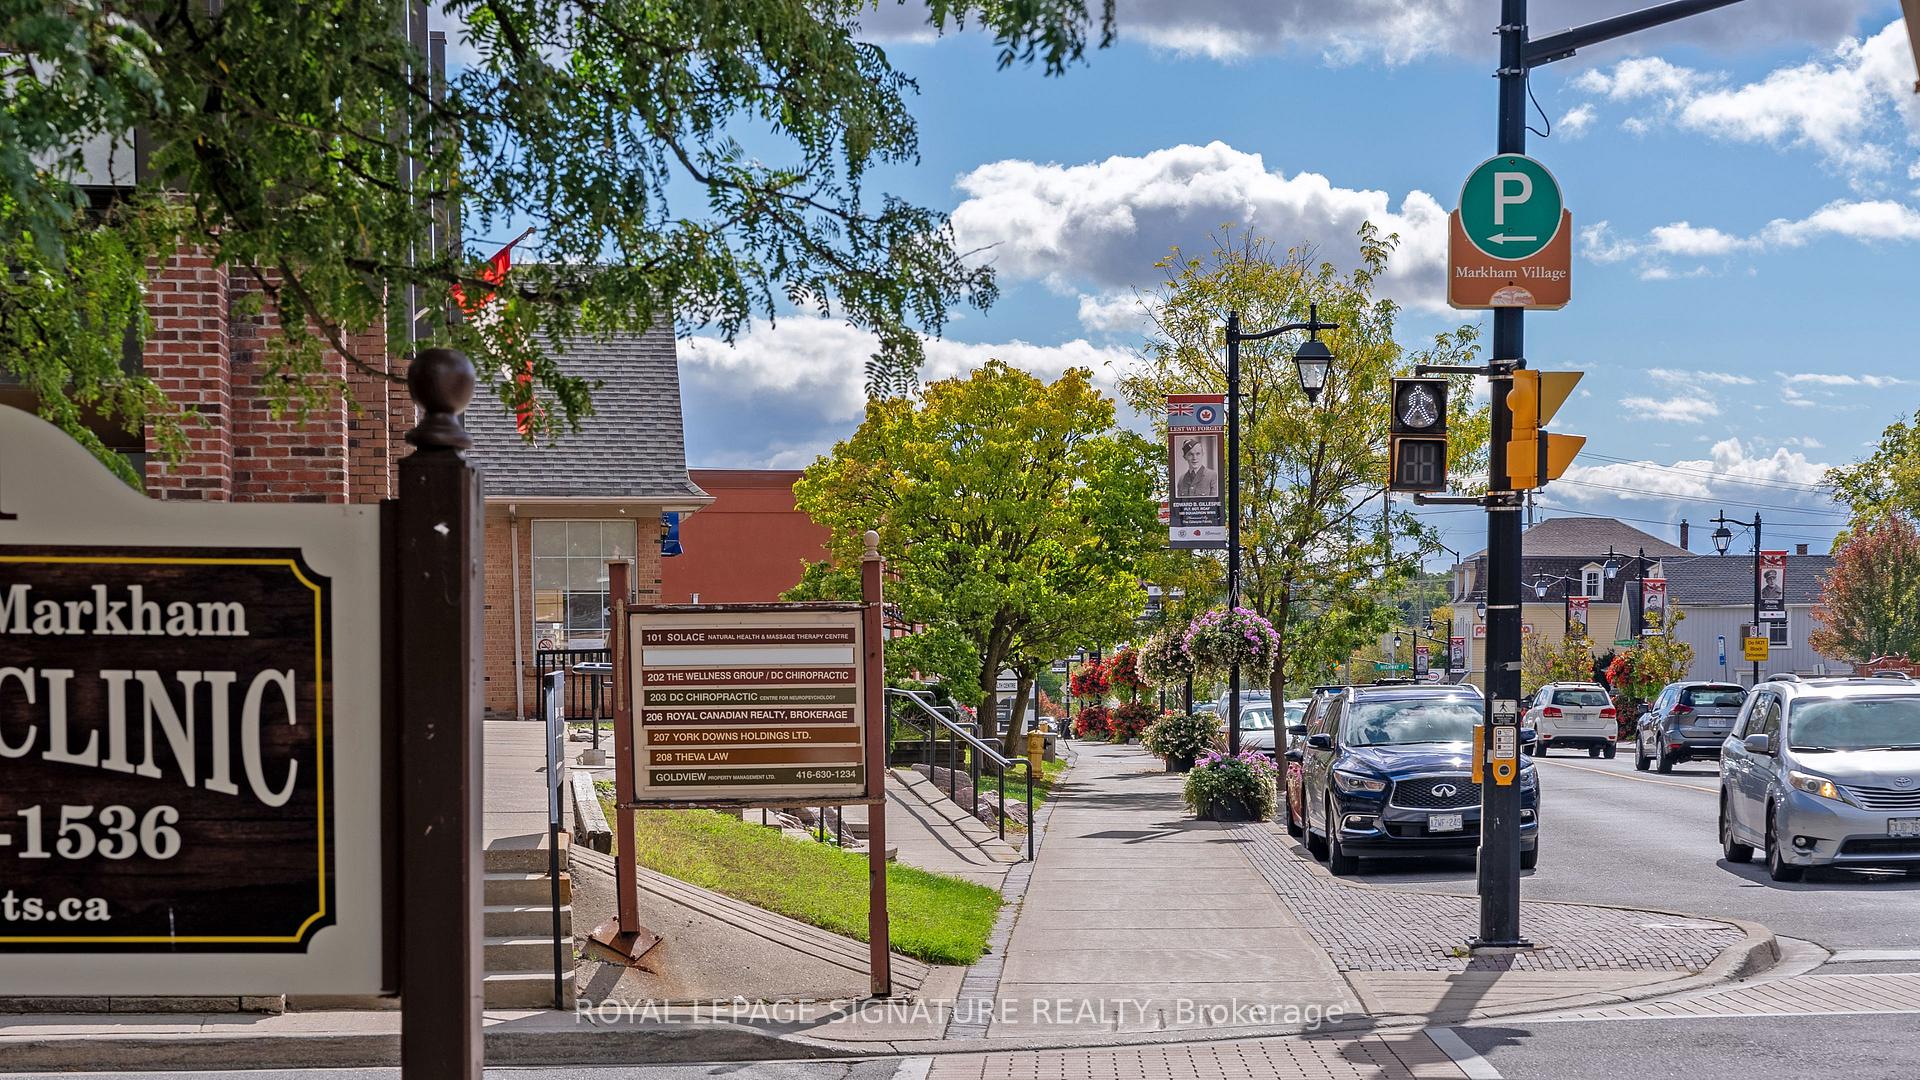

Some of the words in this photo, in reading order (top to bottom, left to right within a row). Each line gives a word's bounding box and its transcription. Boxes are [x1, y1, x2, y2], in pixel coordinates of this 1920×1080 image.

[1494, 172, 1533, 225] P
[1456, 266, 1517, 278] Markham
[1521, 266, 1566, 281] Village
[0, 584, 249, 636] Markham
[667, 633, 705, 641] SOLACE
[648, 674, 664, 682] 202
[686, 672, 731, 680] WELLNESS
[733, 672, 764, 680] GROUP
[650, 693, 666, 701] 203
[686, 692, 758, 701] CHIROPRACTIC
[646, 713, 663, 721] 206
[666, 712, 698, 720] ROYAL
[700, 711, 748, 720] CANADIAN
[750, 711, 788, 720] REALTY,
[0, 667, 298, 807] CLINIC
[654, 734, 670, 742] 207
[702, 732, 738, 740] DOWNS
[740, 732, 789, 740] HOLDINGS
[656, 773, 706, 781] GOLDVIEW
[796, 770, 856, 779] 416-630-1234
[0, 804, 182, 860] -1536
[0, 890, 112, 921] ts.ca
